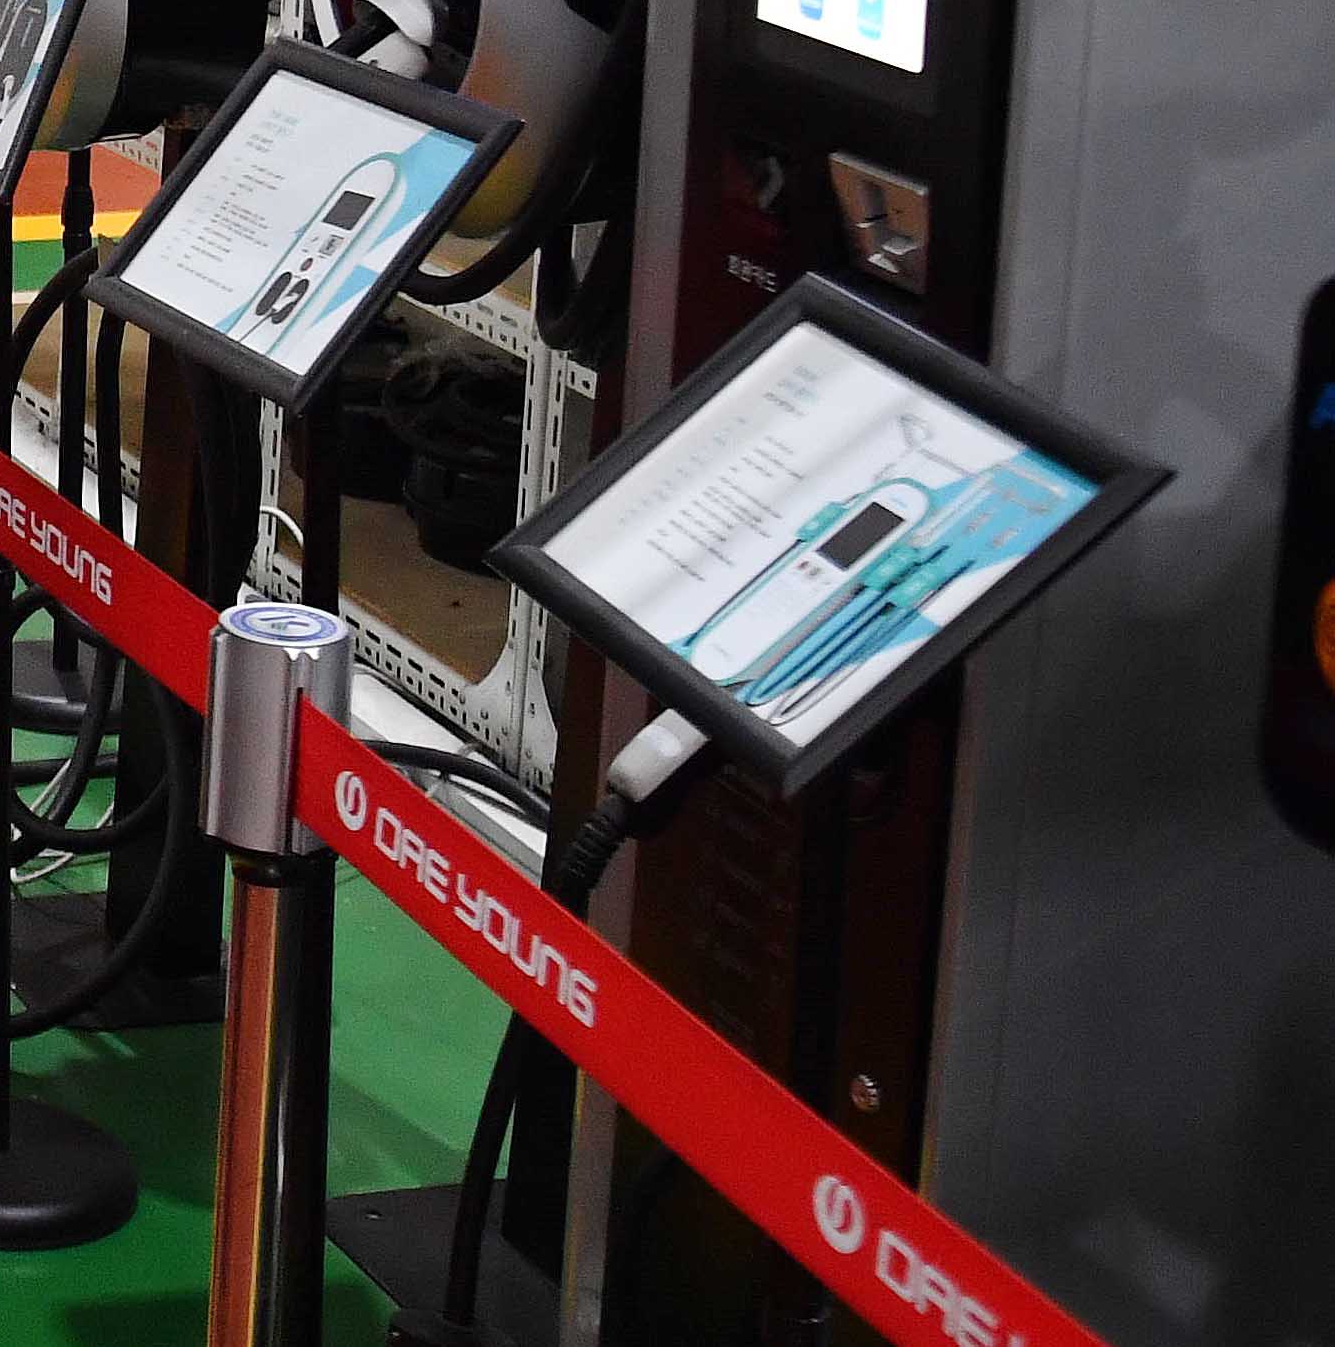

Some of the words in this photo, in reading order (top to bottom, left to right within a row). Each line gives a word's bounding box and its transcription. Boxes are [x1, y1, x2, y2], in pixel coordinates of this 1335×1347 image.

[30, 510, 113, 606] YOUNG
[373, 807, 450, 904] DAE
[452, 872, 598, 1029] YOUNG
